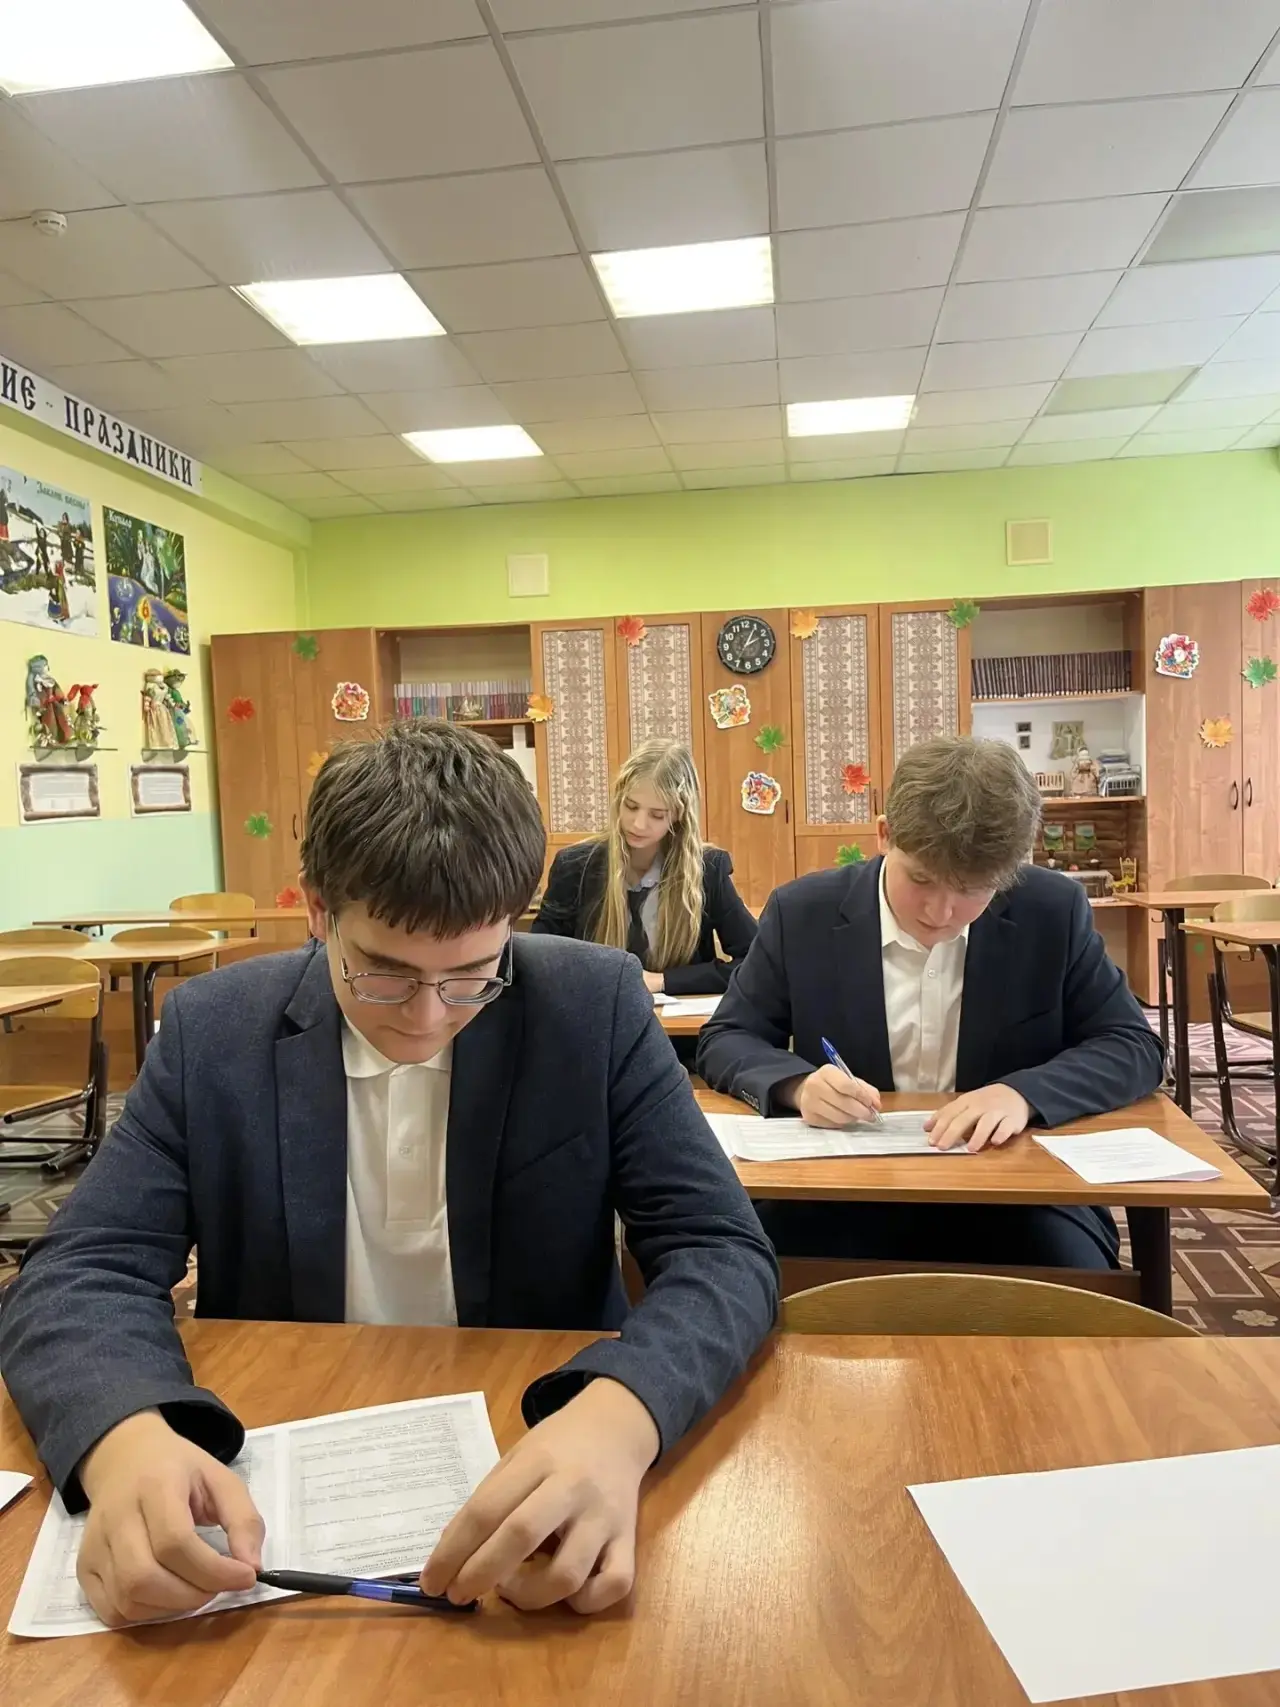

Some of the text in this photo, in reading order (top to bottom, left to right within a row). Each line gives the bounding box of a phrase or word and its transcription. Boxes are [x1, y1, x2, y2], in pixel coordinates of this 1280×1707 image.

[64, 395, 193, 486] ПРАЗДНИКИ
[740, 620, 750, 628] 12
[732, 625, 740, 633] 11
[761, 629, 767, 637] 2
[725, 632, 734, 641] 10
[723, 643, 729, 651] 9
[764, 639, 770, 647] 3
[727, 653, 733, 661] 8
[735, 660, 741, 668] 7
[745, 661, 751, 669] 6
[755, 658, 761, 666] 5
